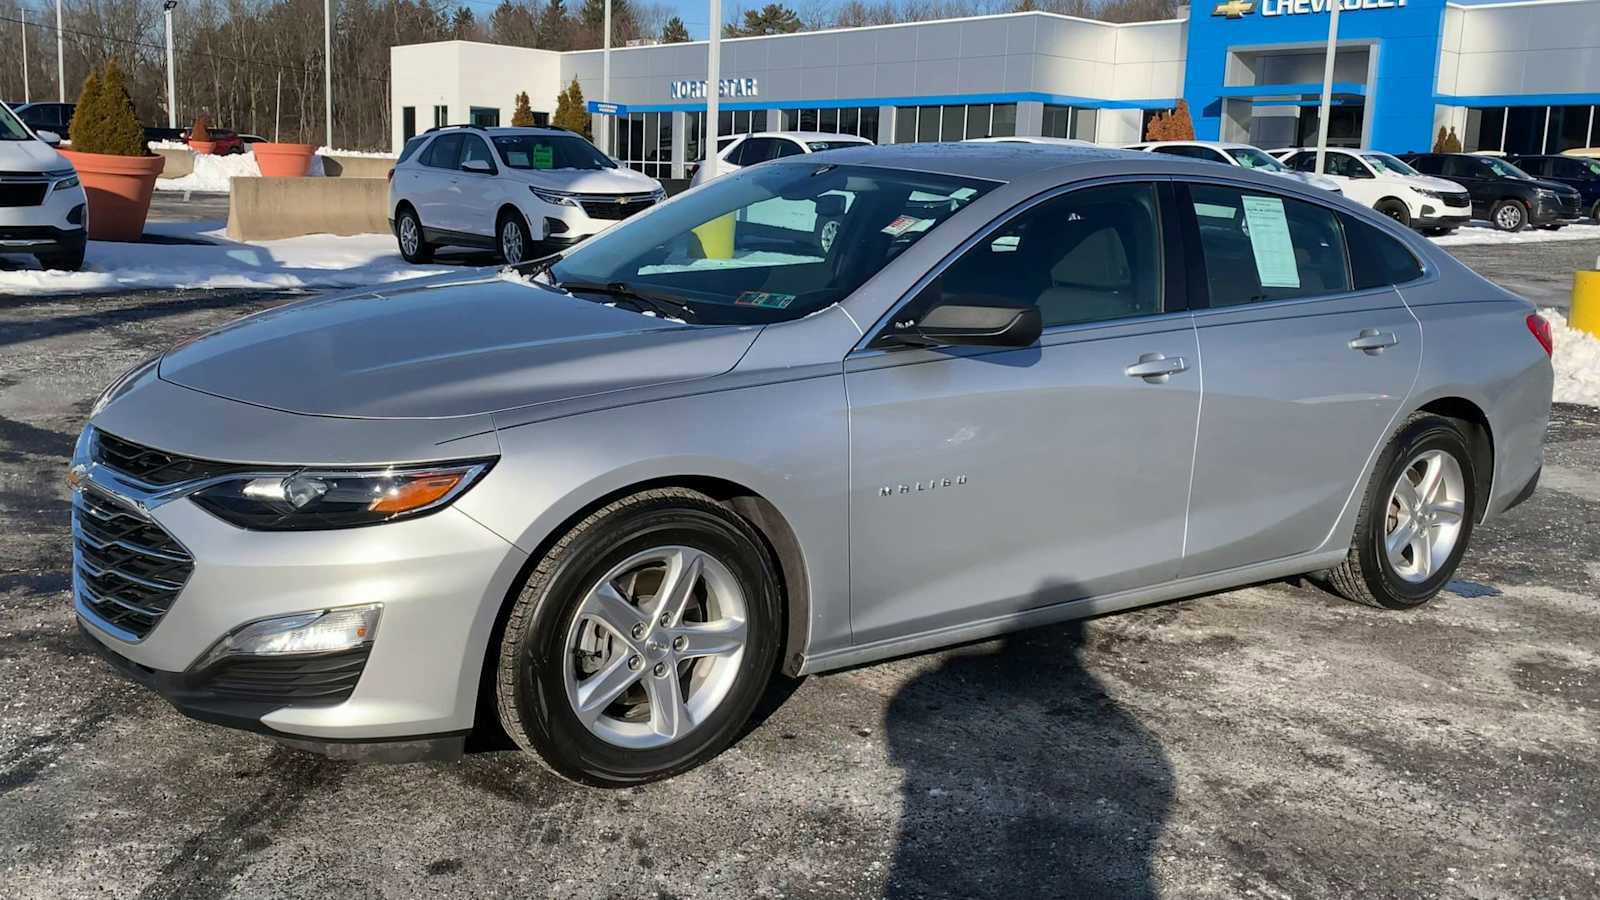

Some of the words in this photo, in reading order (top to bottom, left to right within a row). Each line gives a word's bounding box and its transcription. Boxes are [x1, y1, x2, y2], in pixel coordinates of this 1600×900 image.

[1262, 0, 1407, 16] CHEVO
[671, 78, 758, 99] NORTSTAR
[879, 474, 968, 497] MALIBU
